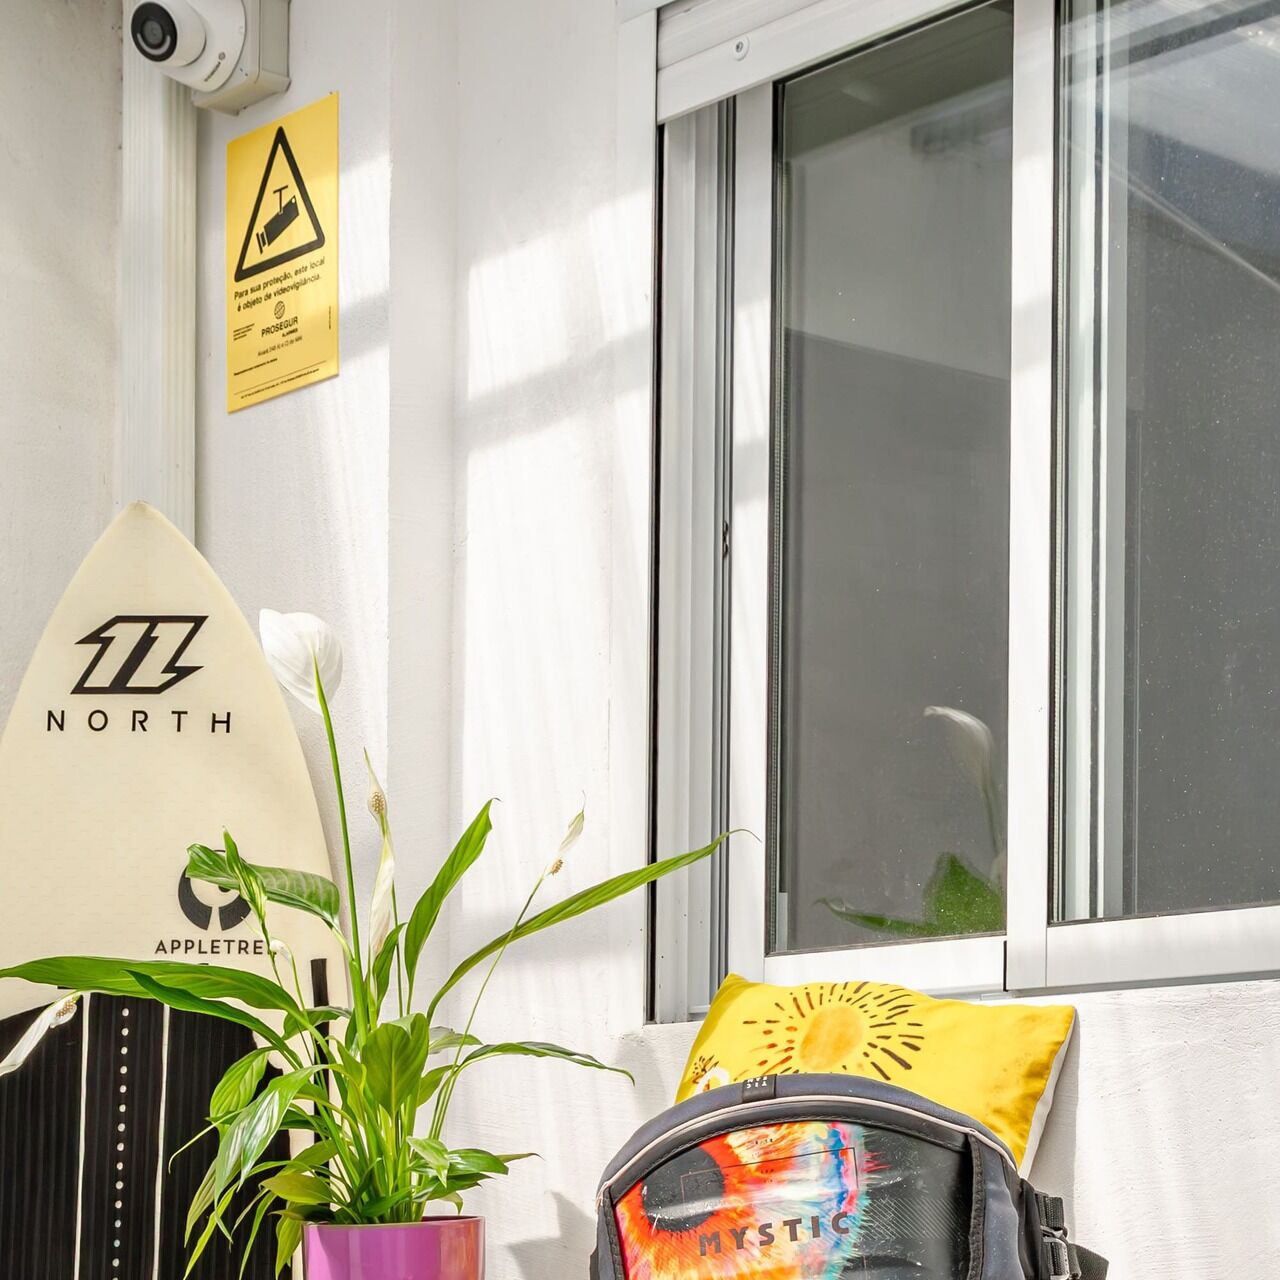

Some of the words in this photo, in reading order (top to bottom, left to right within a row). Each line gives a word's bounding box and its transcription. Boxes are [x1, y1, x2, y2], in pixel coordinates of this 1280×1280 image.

[234, 289, 248, 300] Para
[250, 284, 261, 294] sua
[294, 265, 308, 276] este
[310, 256, 325, 269] local
[242, 296, 262, 311] objeto
[264, 291, 272, 301] de
[261, 316, 298, 337] PROSEGUR
[47, 709, 231, 733] NORTH
[154, 939, 277, 955] APPLETRE
[699, 1212, 850, 1256] MYSTIC
